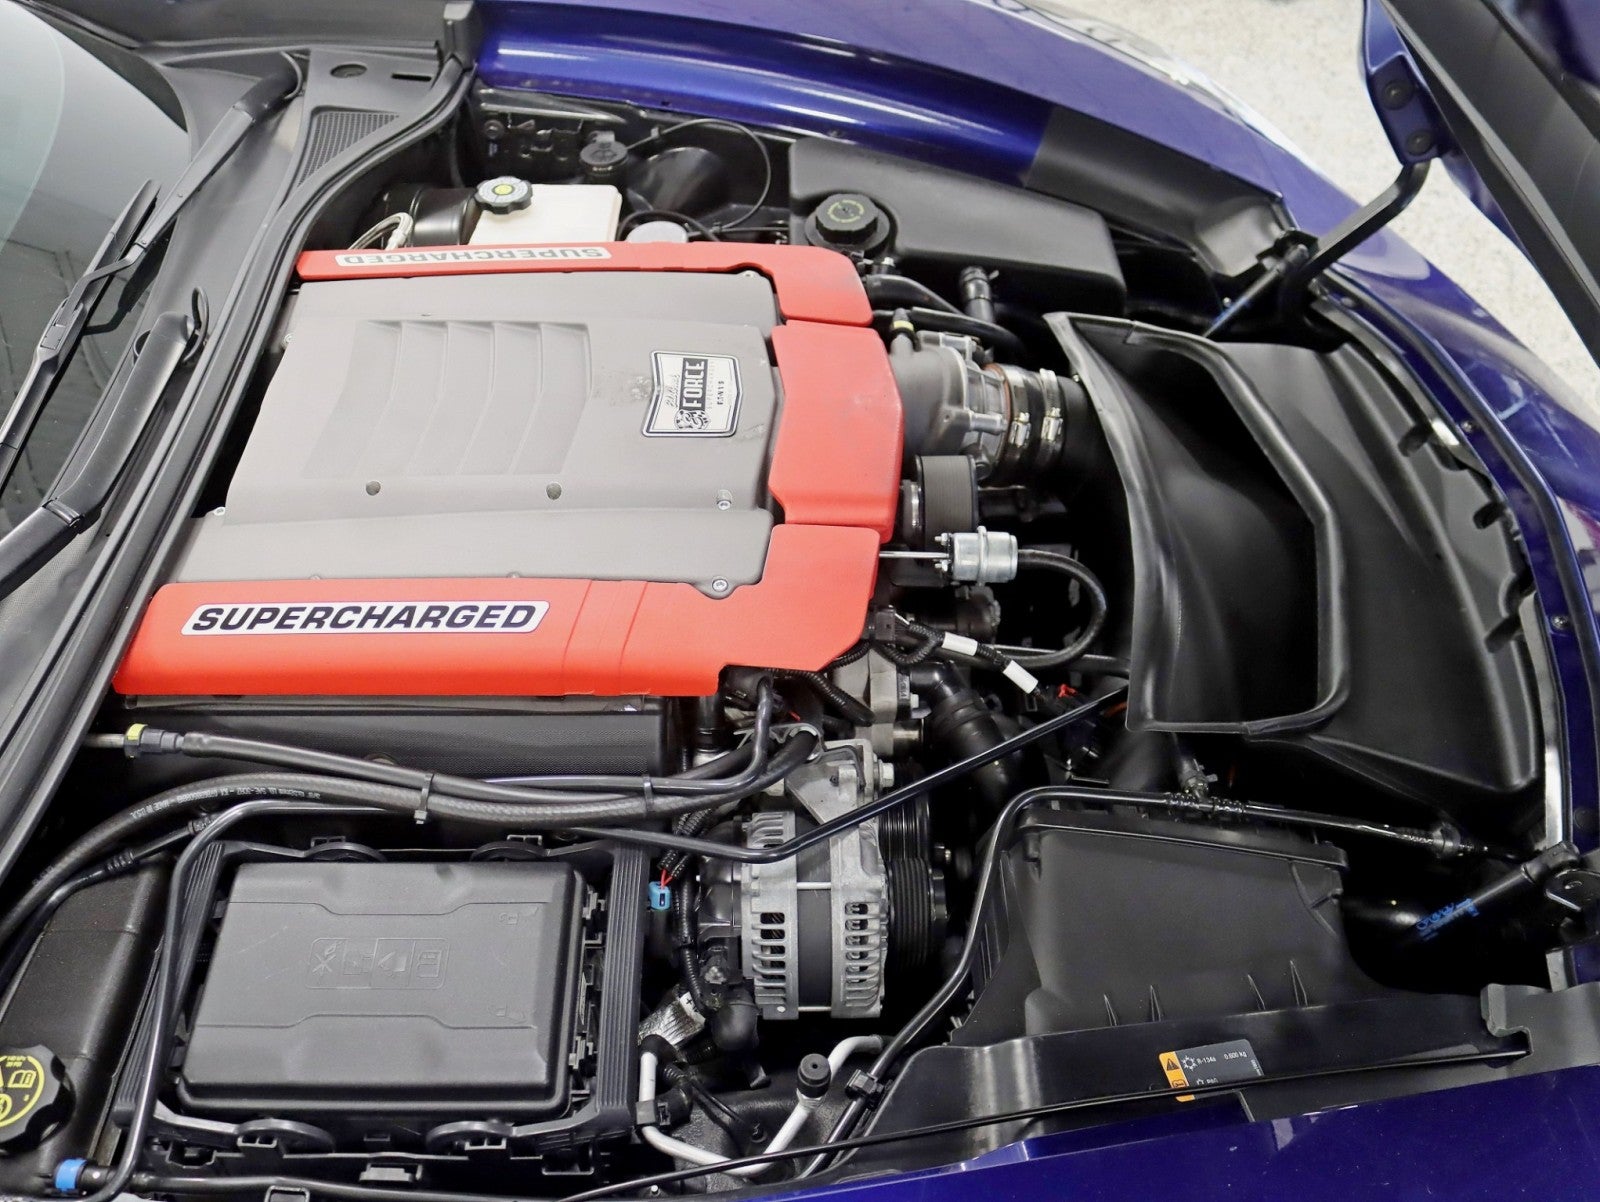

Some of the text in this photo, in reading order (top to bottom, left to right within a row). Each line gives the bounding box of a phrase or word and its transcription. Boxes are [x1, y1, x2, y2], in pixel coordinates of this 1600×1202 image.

[343, 247, 605, 265] SUPERCHARGED
[682, 361, 705, 408] FORCE
[192, 604, 537, 631] SUPERCHARGED
